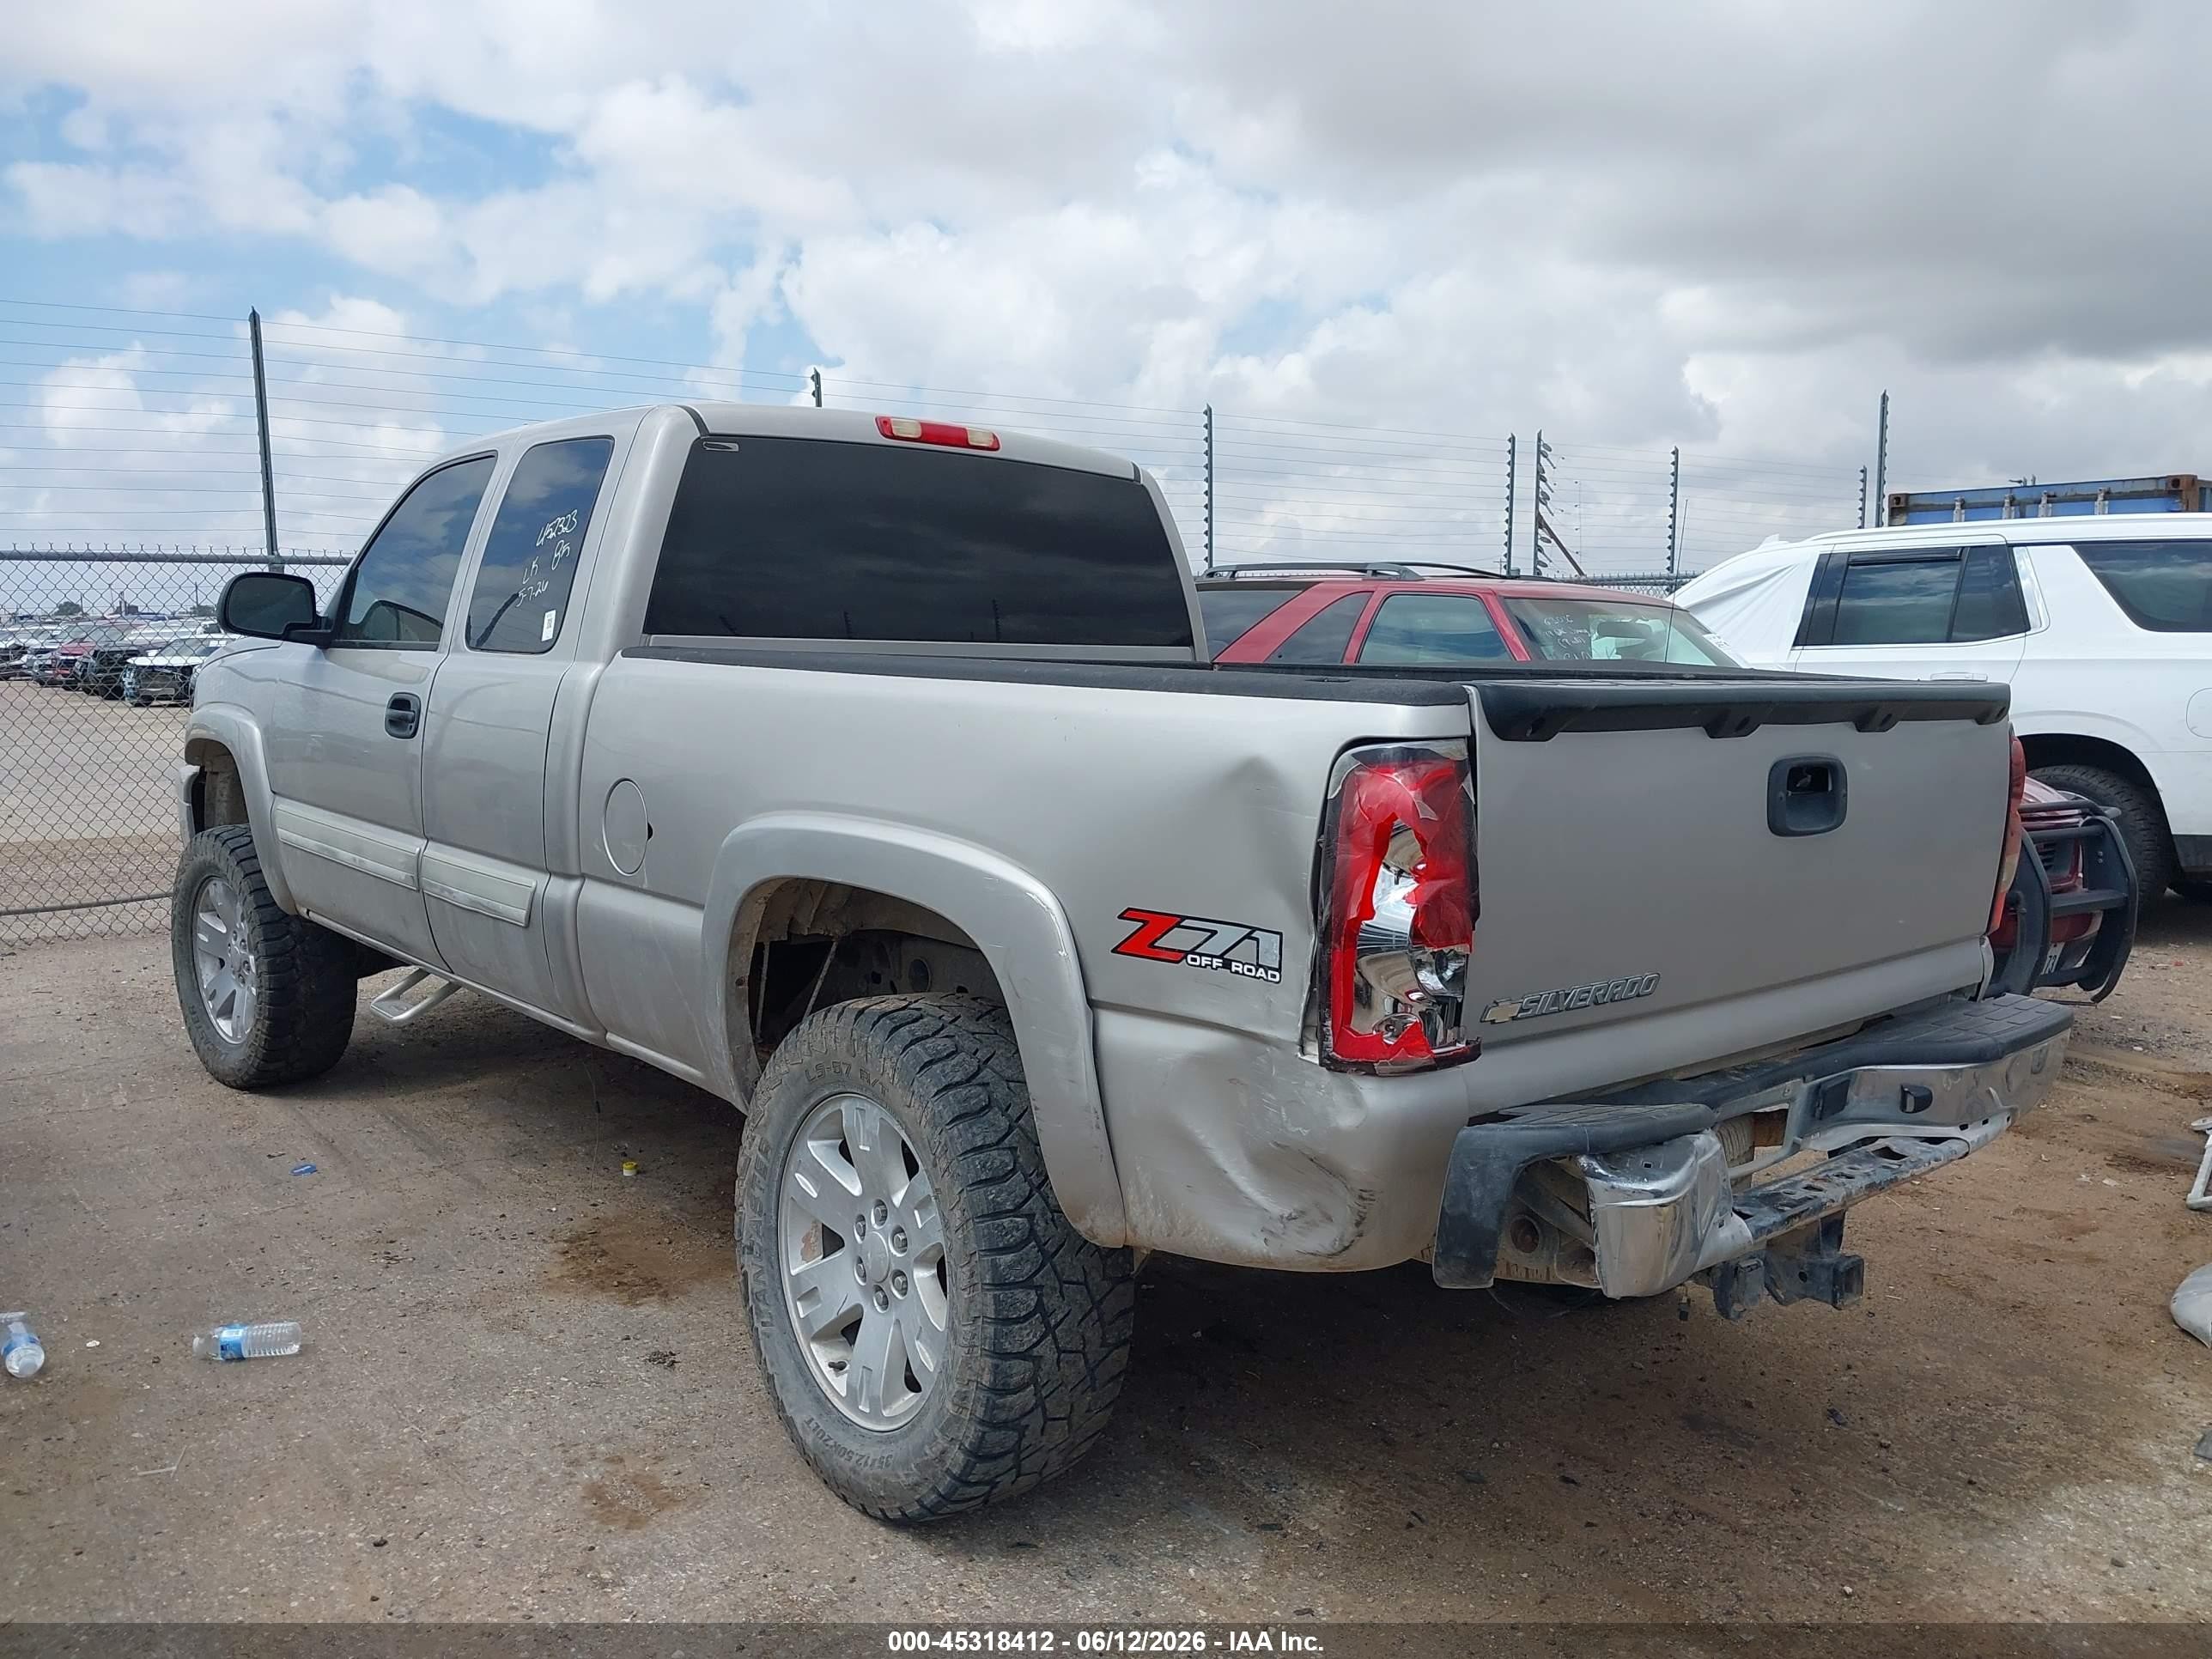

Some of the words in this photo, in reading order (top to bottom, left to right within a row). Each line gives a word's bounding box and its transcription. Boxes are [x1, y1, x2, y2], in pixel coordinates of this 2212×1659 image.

[1110, 907, 1283, 971] Z71
[1186, 953, 1224, 969] OFF
[1231, 961, 1281, 983] ROAD
[1516, 973, 1661, 1018] SILVERADO
